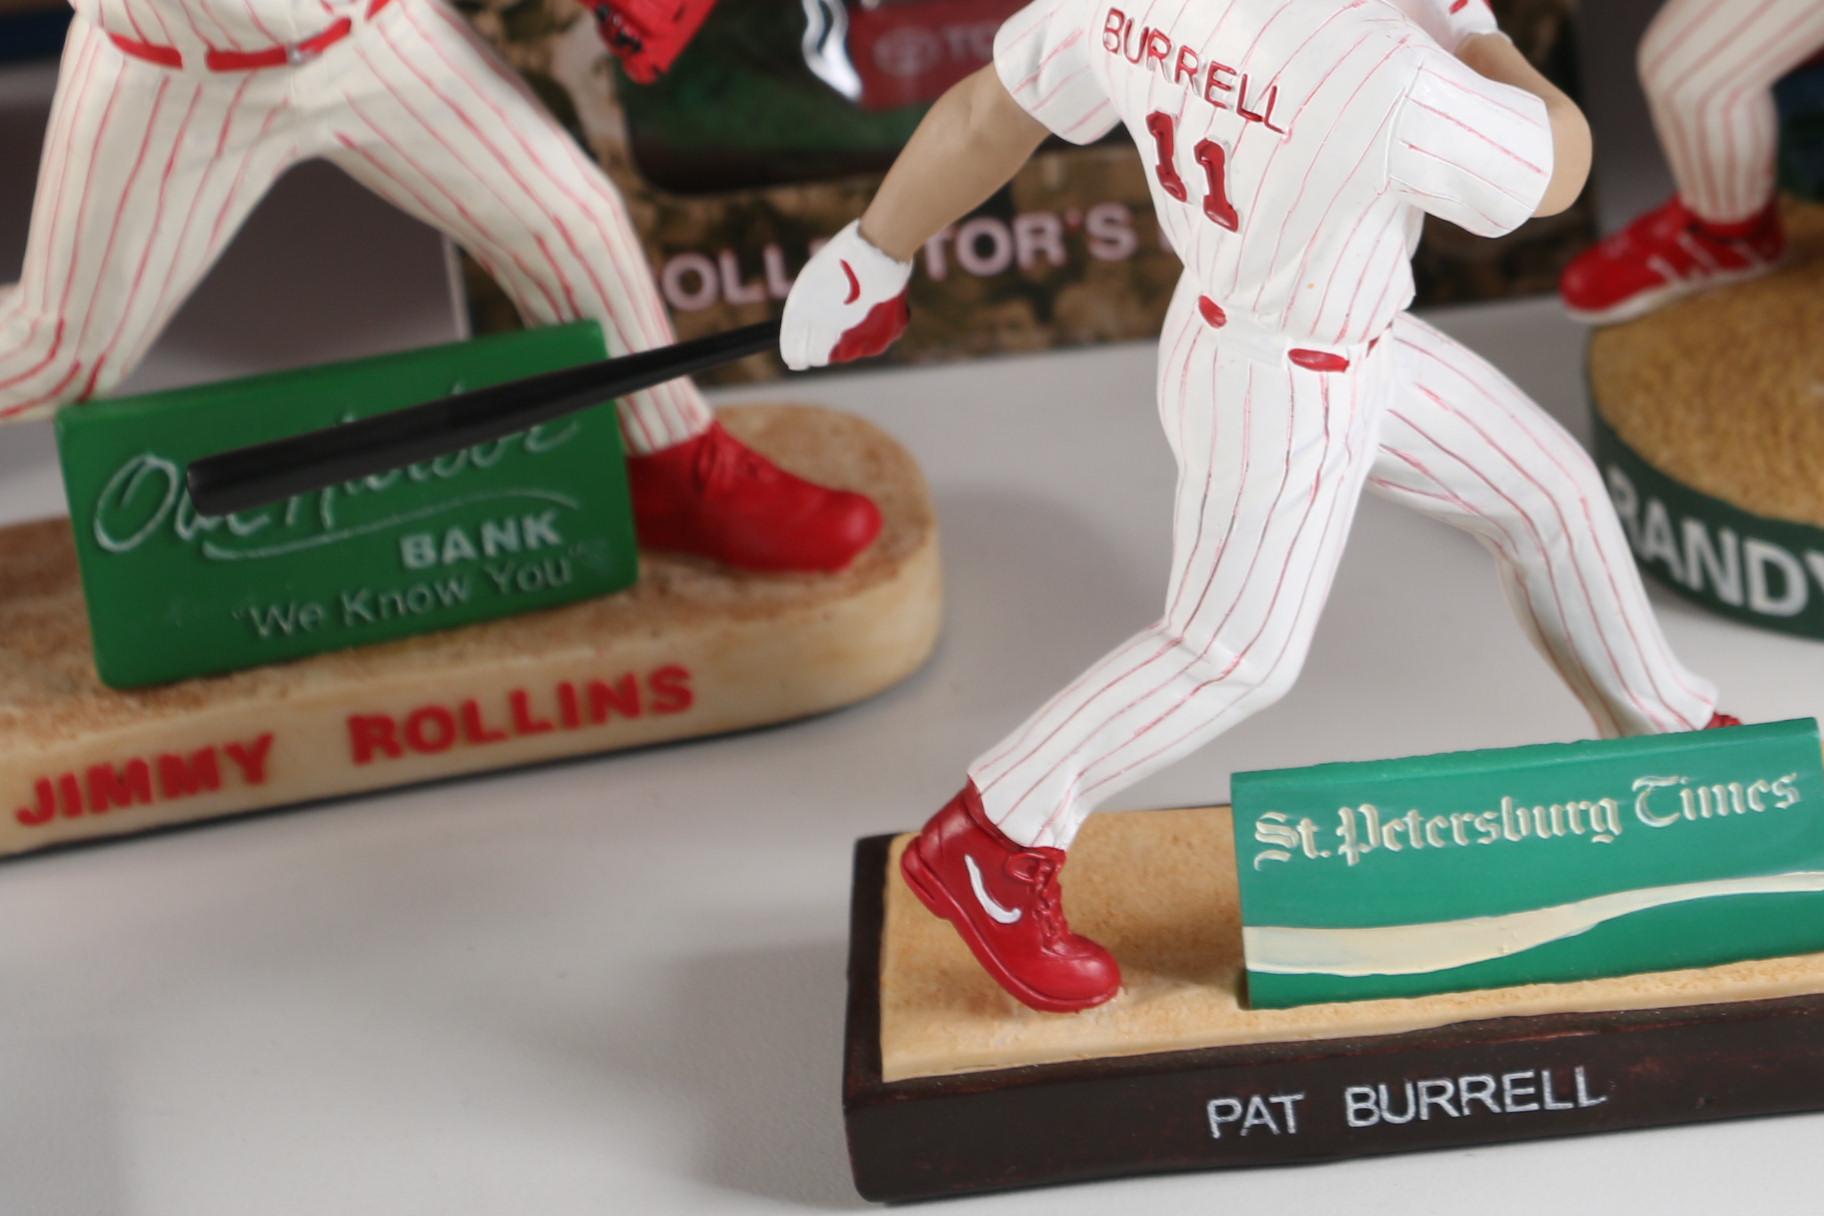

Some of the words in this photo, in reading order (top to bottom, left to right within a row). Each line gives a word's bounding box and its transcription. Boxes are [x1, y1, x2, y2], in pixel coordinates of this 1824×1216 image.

[1102, 7, 1287, 136] BURRELL
[1145, 110, 1240, 233] 11
[401, 513, 562, 569] BANK
[339, 578, 471, 627] Know
[15, 732, 275, 827] JIMMY
[346, 664, 695, 766] ROLLINS
[1253, 811, 1332, 871] St.
[1336, 795, 1623, 867] Petersburg
[1631, 771, 1801, 829] Times
[1206, 1093, 1305, 1139] PAT
[1344, 1066, 1608, 1129] BURRELL
